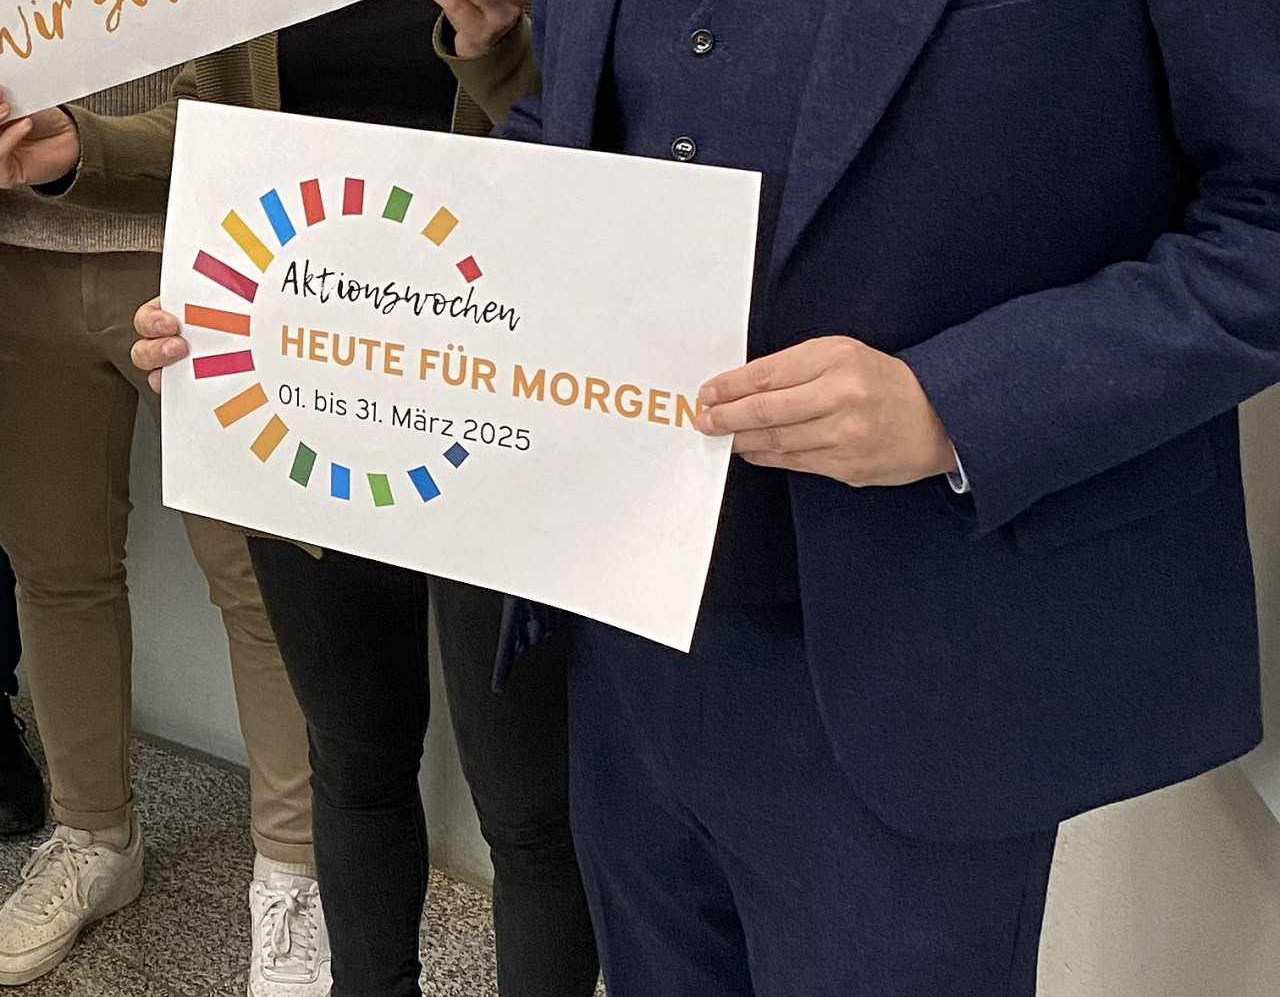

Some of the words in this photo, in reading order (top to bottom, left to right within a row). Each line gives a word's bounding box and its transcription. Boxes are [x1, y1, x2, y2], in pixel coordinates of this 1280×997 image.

[280, 260, 521, 332] Aktionswochen
[280, 324, 405, 376] HEUTE
[419, 344, 497, 393] FÜR
[512, 364, 703, 430] MORGEN
[279, 384, 307, 407] 01.
[315, 390, 348, 415] bis
[355, 398, 384, 423] 31.
[391, 405, 456, 437] März
[463, 419, 531, 452] 2025
